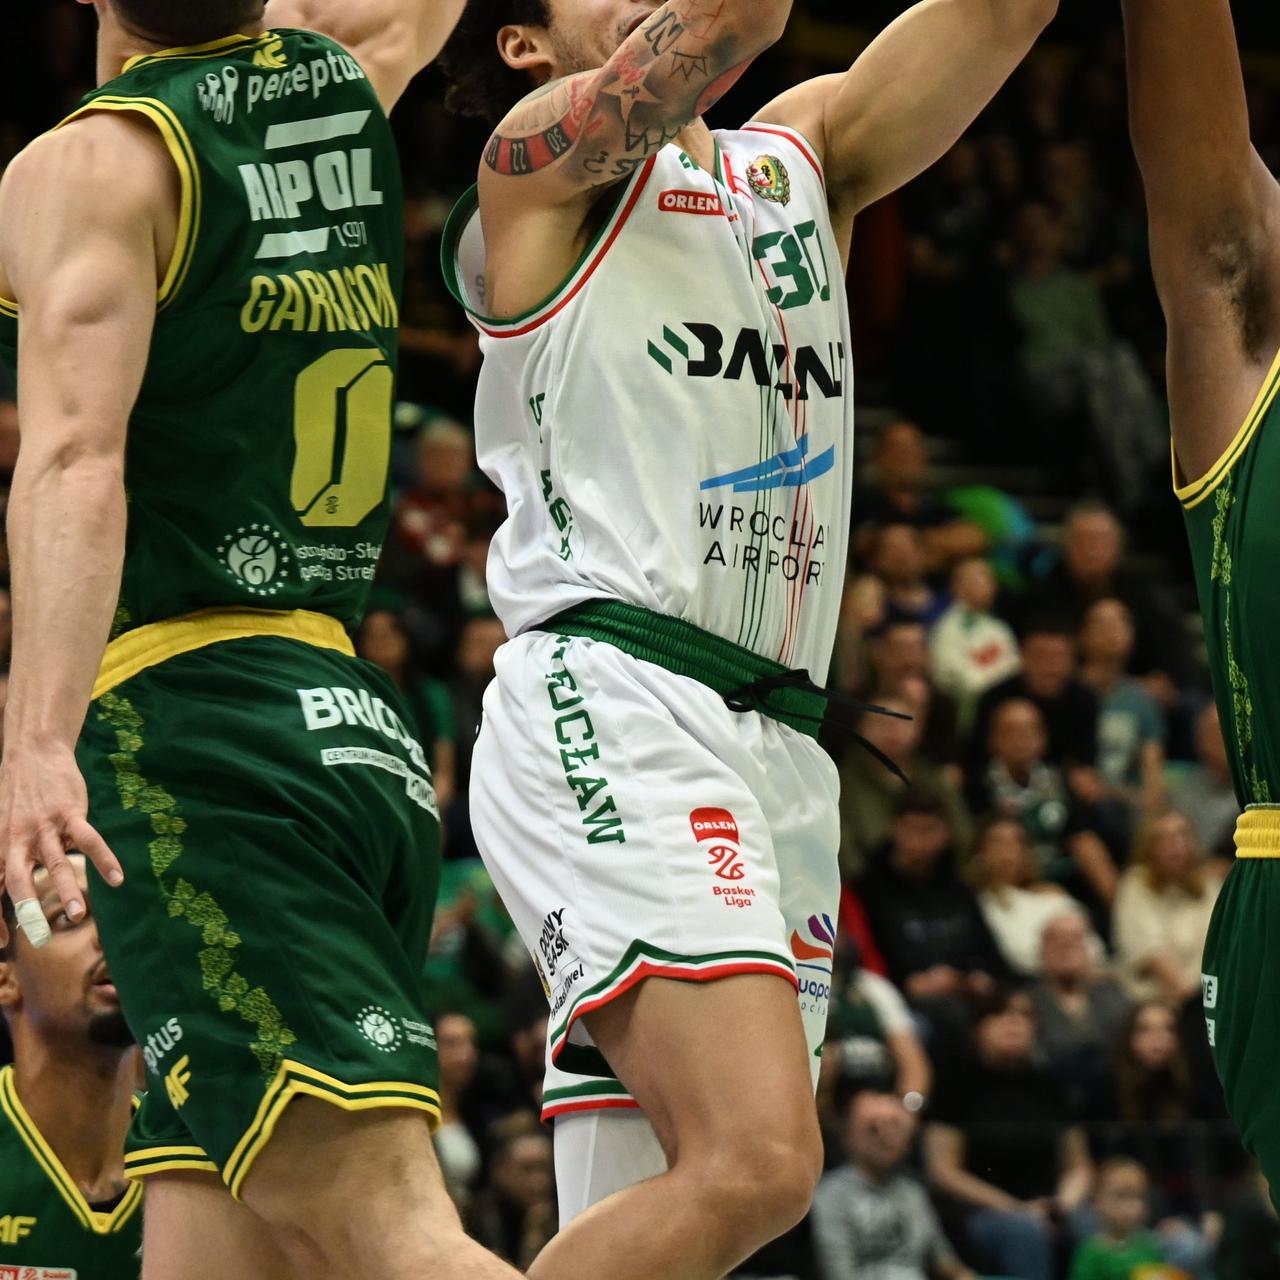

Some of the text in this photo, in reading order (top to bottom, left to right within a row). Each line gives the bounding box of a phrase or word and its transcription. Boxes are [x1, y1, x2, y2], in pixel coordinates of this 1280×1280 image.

[664, 194, 719, 211] ORLEN
[290, 347, 394, 527] 0
[693, 821, 737, 832] ORLEN
[712, 885, 756, 898] Basket
[725, 896, 752, 908] Liga
